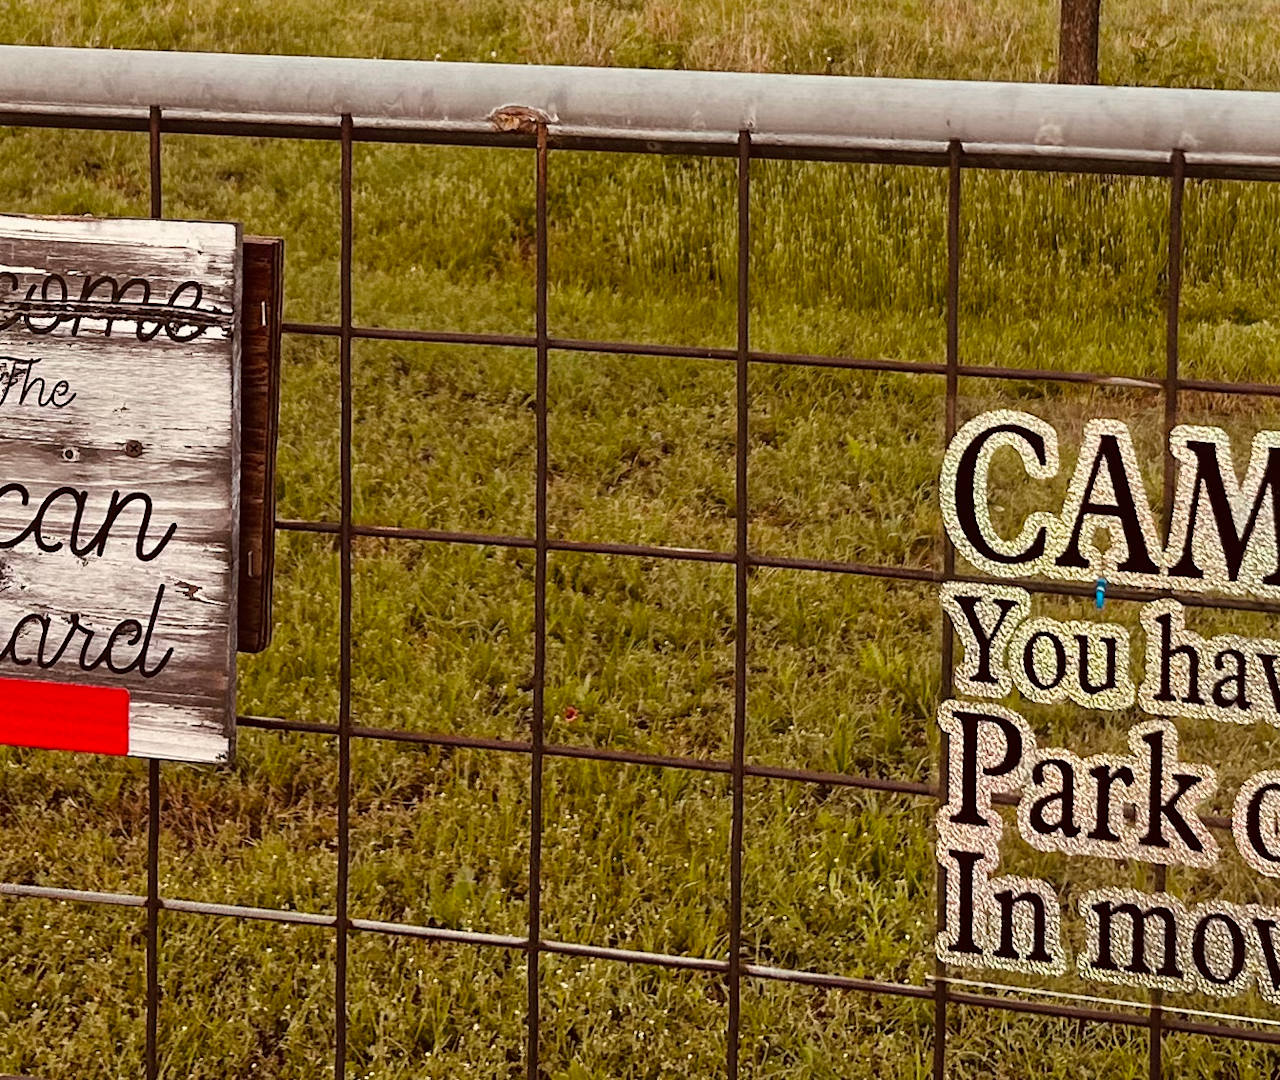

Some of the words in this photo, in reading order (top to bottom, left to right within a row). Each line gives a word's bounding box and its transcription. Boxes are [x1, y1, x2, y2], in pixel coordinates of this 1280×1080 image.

[953, 594, 1118, 695] You
[950, 712, 1205, 853] Park
[947, 852, 1051, 964] In
